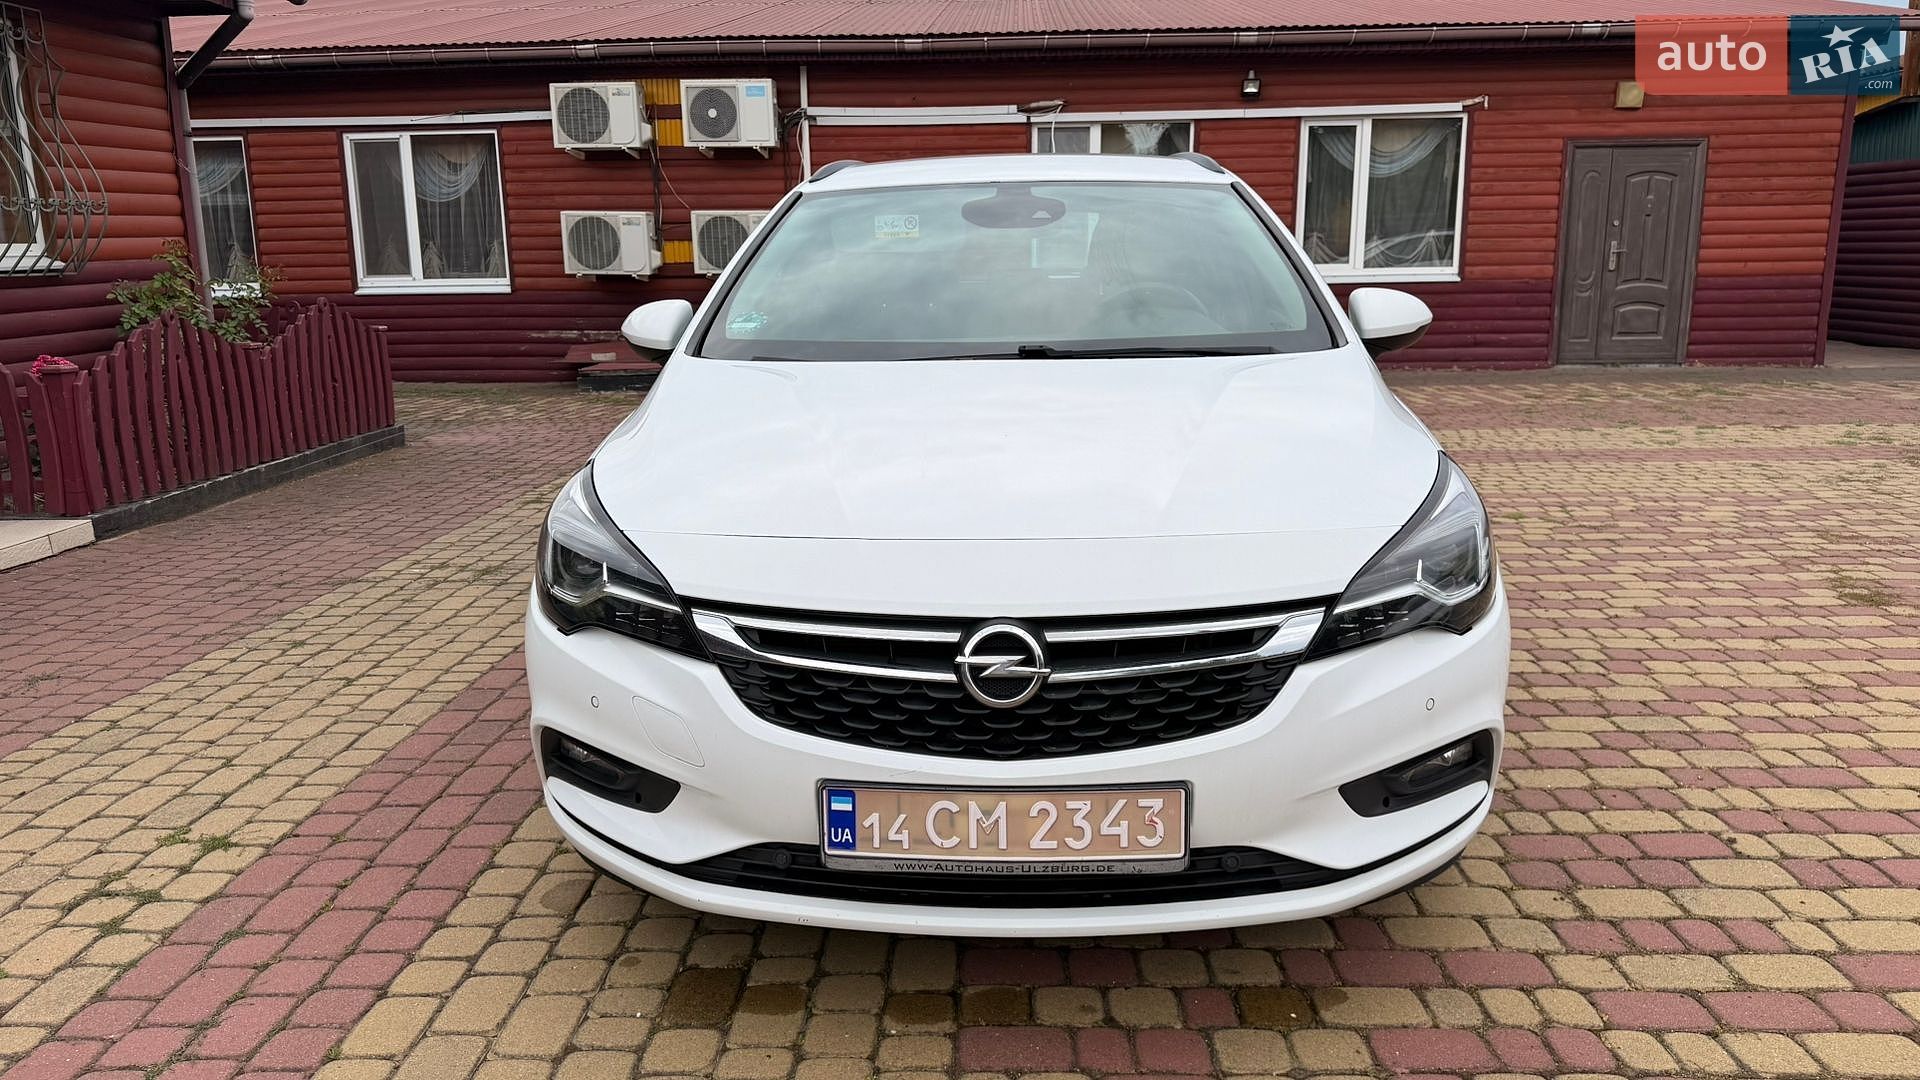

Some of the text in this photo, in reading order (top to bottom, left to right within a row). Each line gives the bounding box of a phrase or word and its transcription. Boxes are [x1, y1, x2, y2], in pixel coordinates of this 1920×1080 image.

[831, 827, 853, 843] UA
[861, 798, 1165, 850] 14 CM 2343
